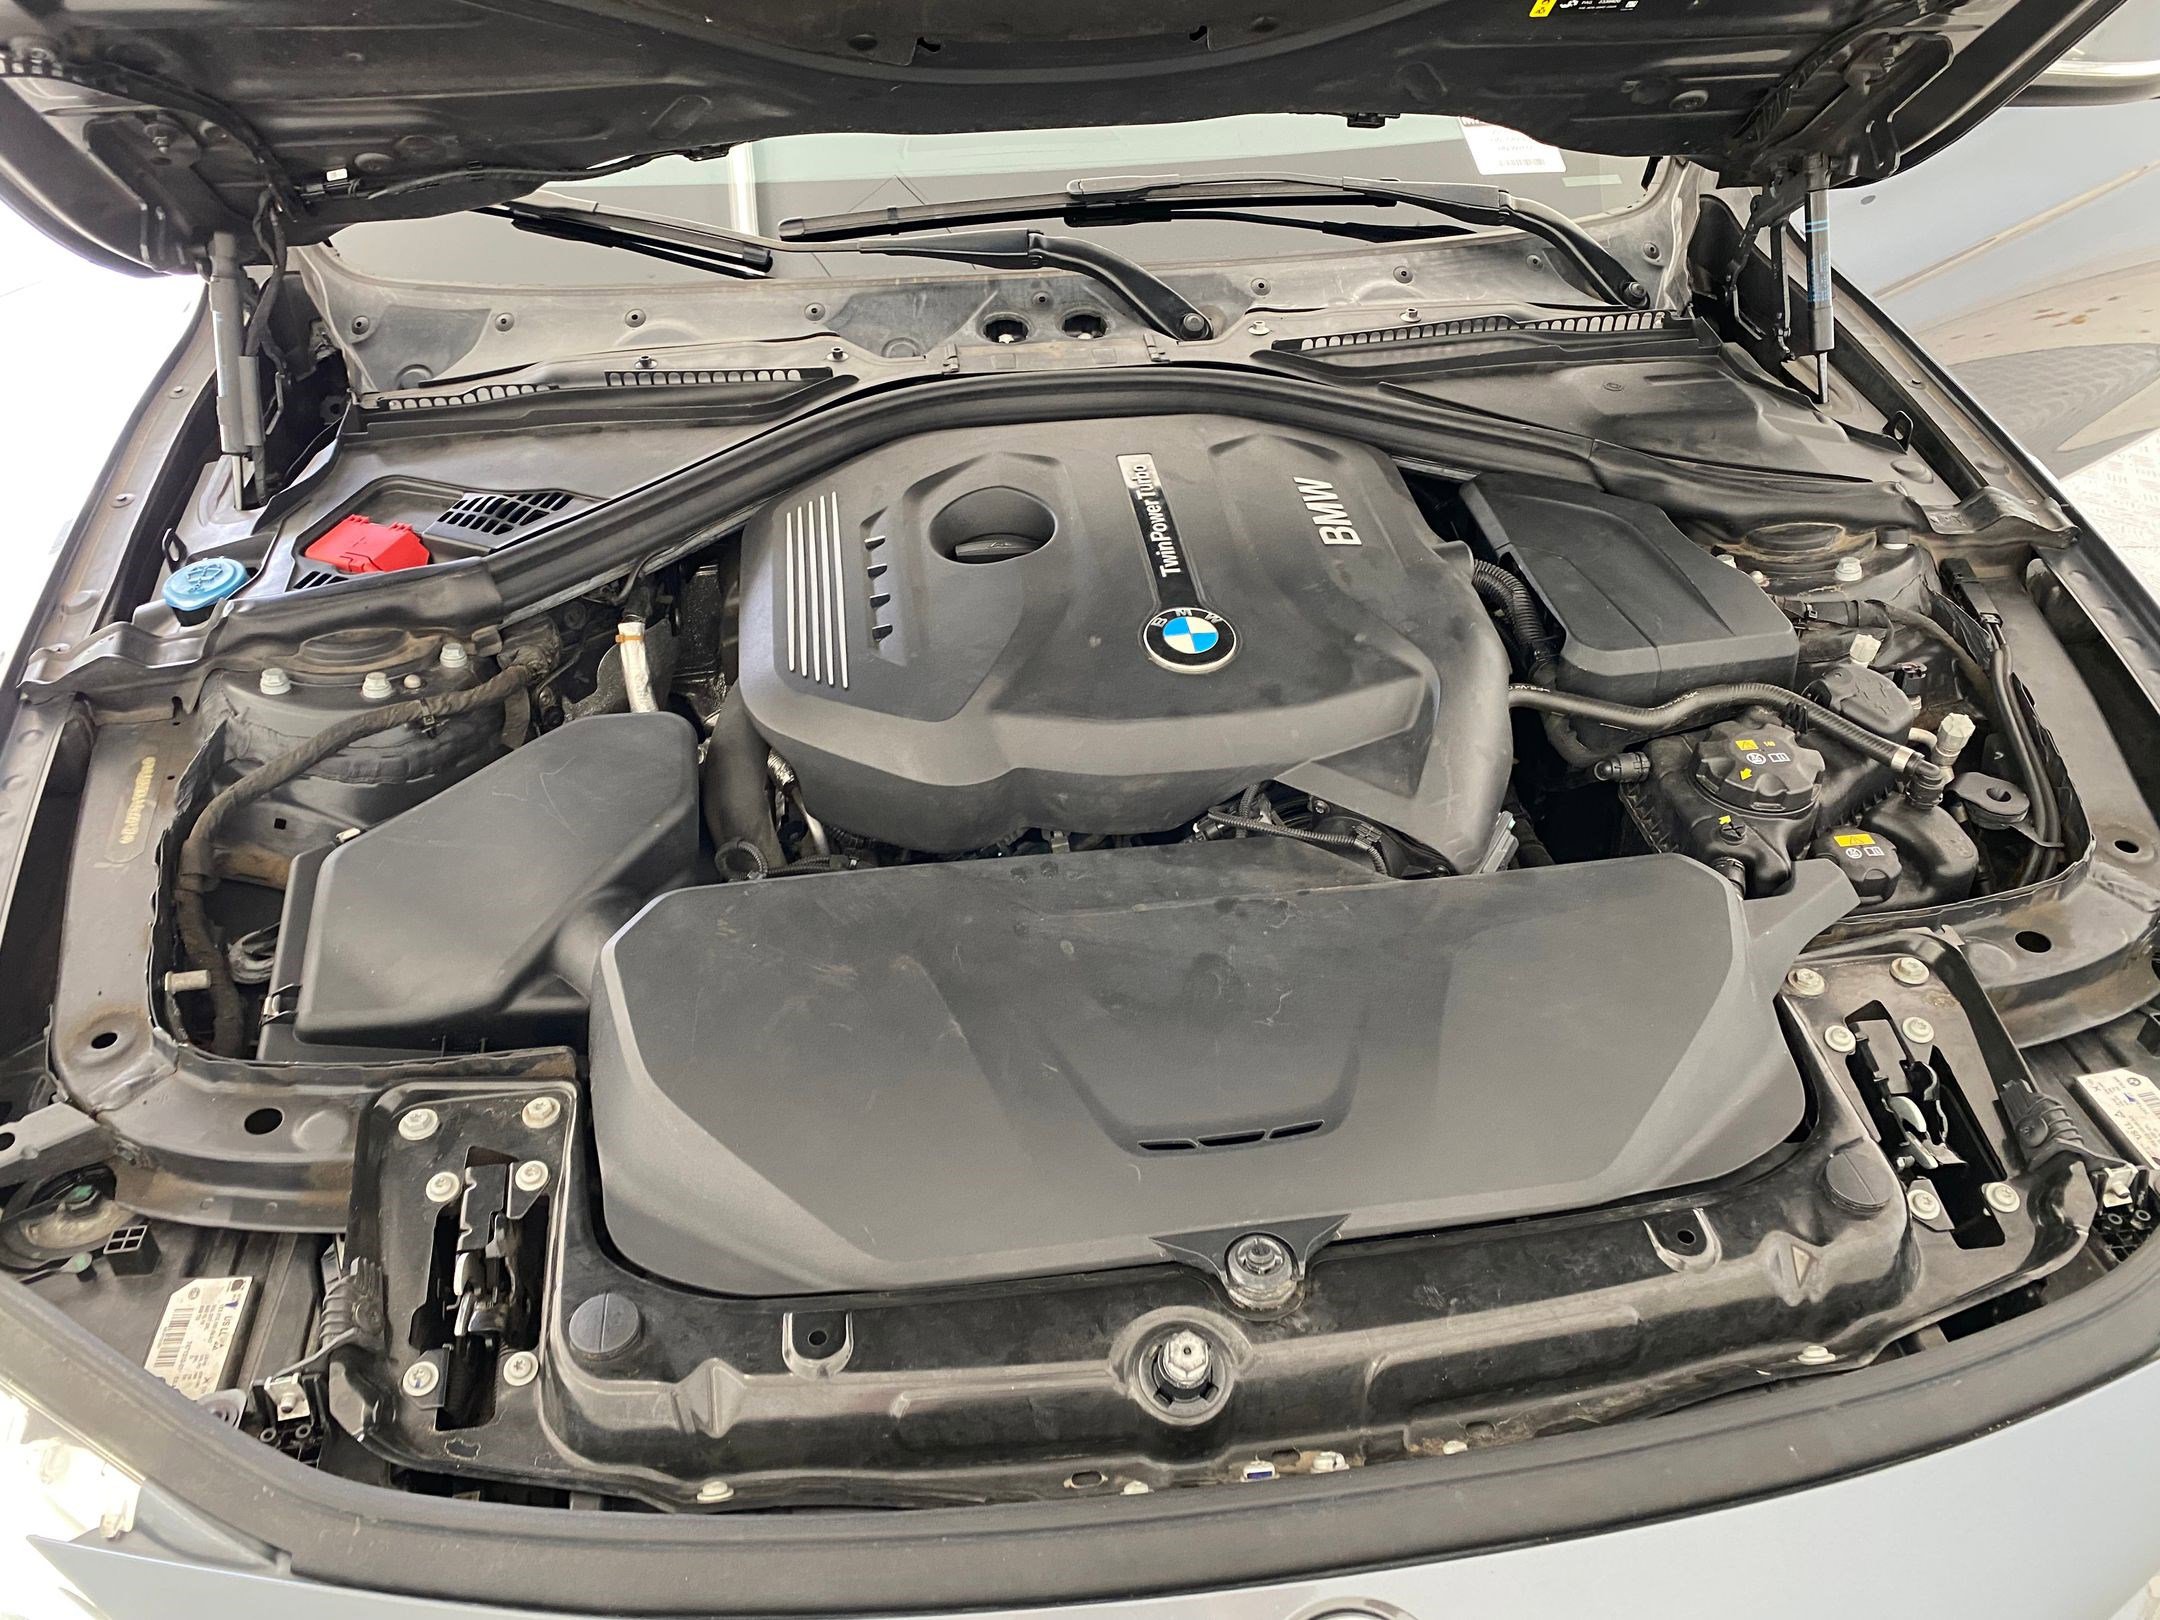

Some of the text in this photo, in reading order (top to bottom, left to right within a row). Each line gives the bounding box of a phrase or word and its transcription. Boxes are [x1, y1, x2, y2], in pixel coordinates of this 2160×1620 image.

[1132, 464, 1182, 578] TwinPower Turbo
[1293, 476, 1363, 546] BMW
[1151, 607, 1224, 628] BMW
